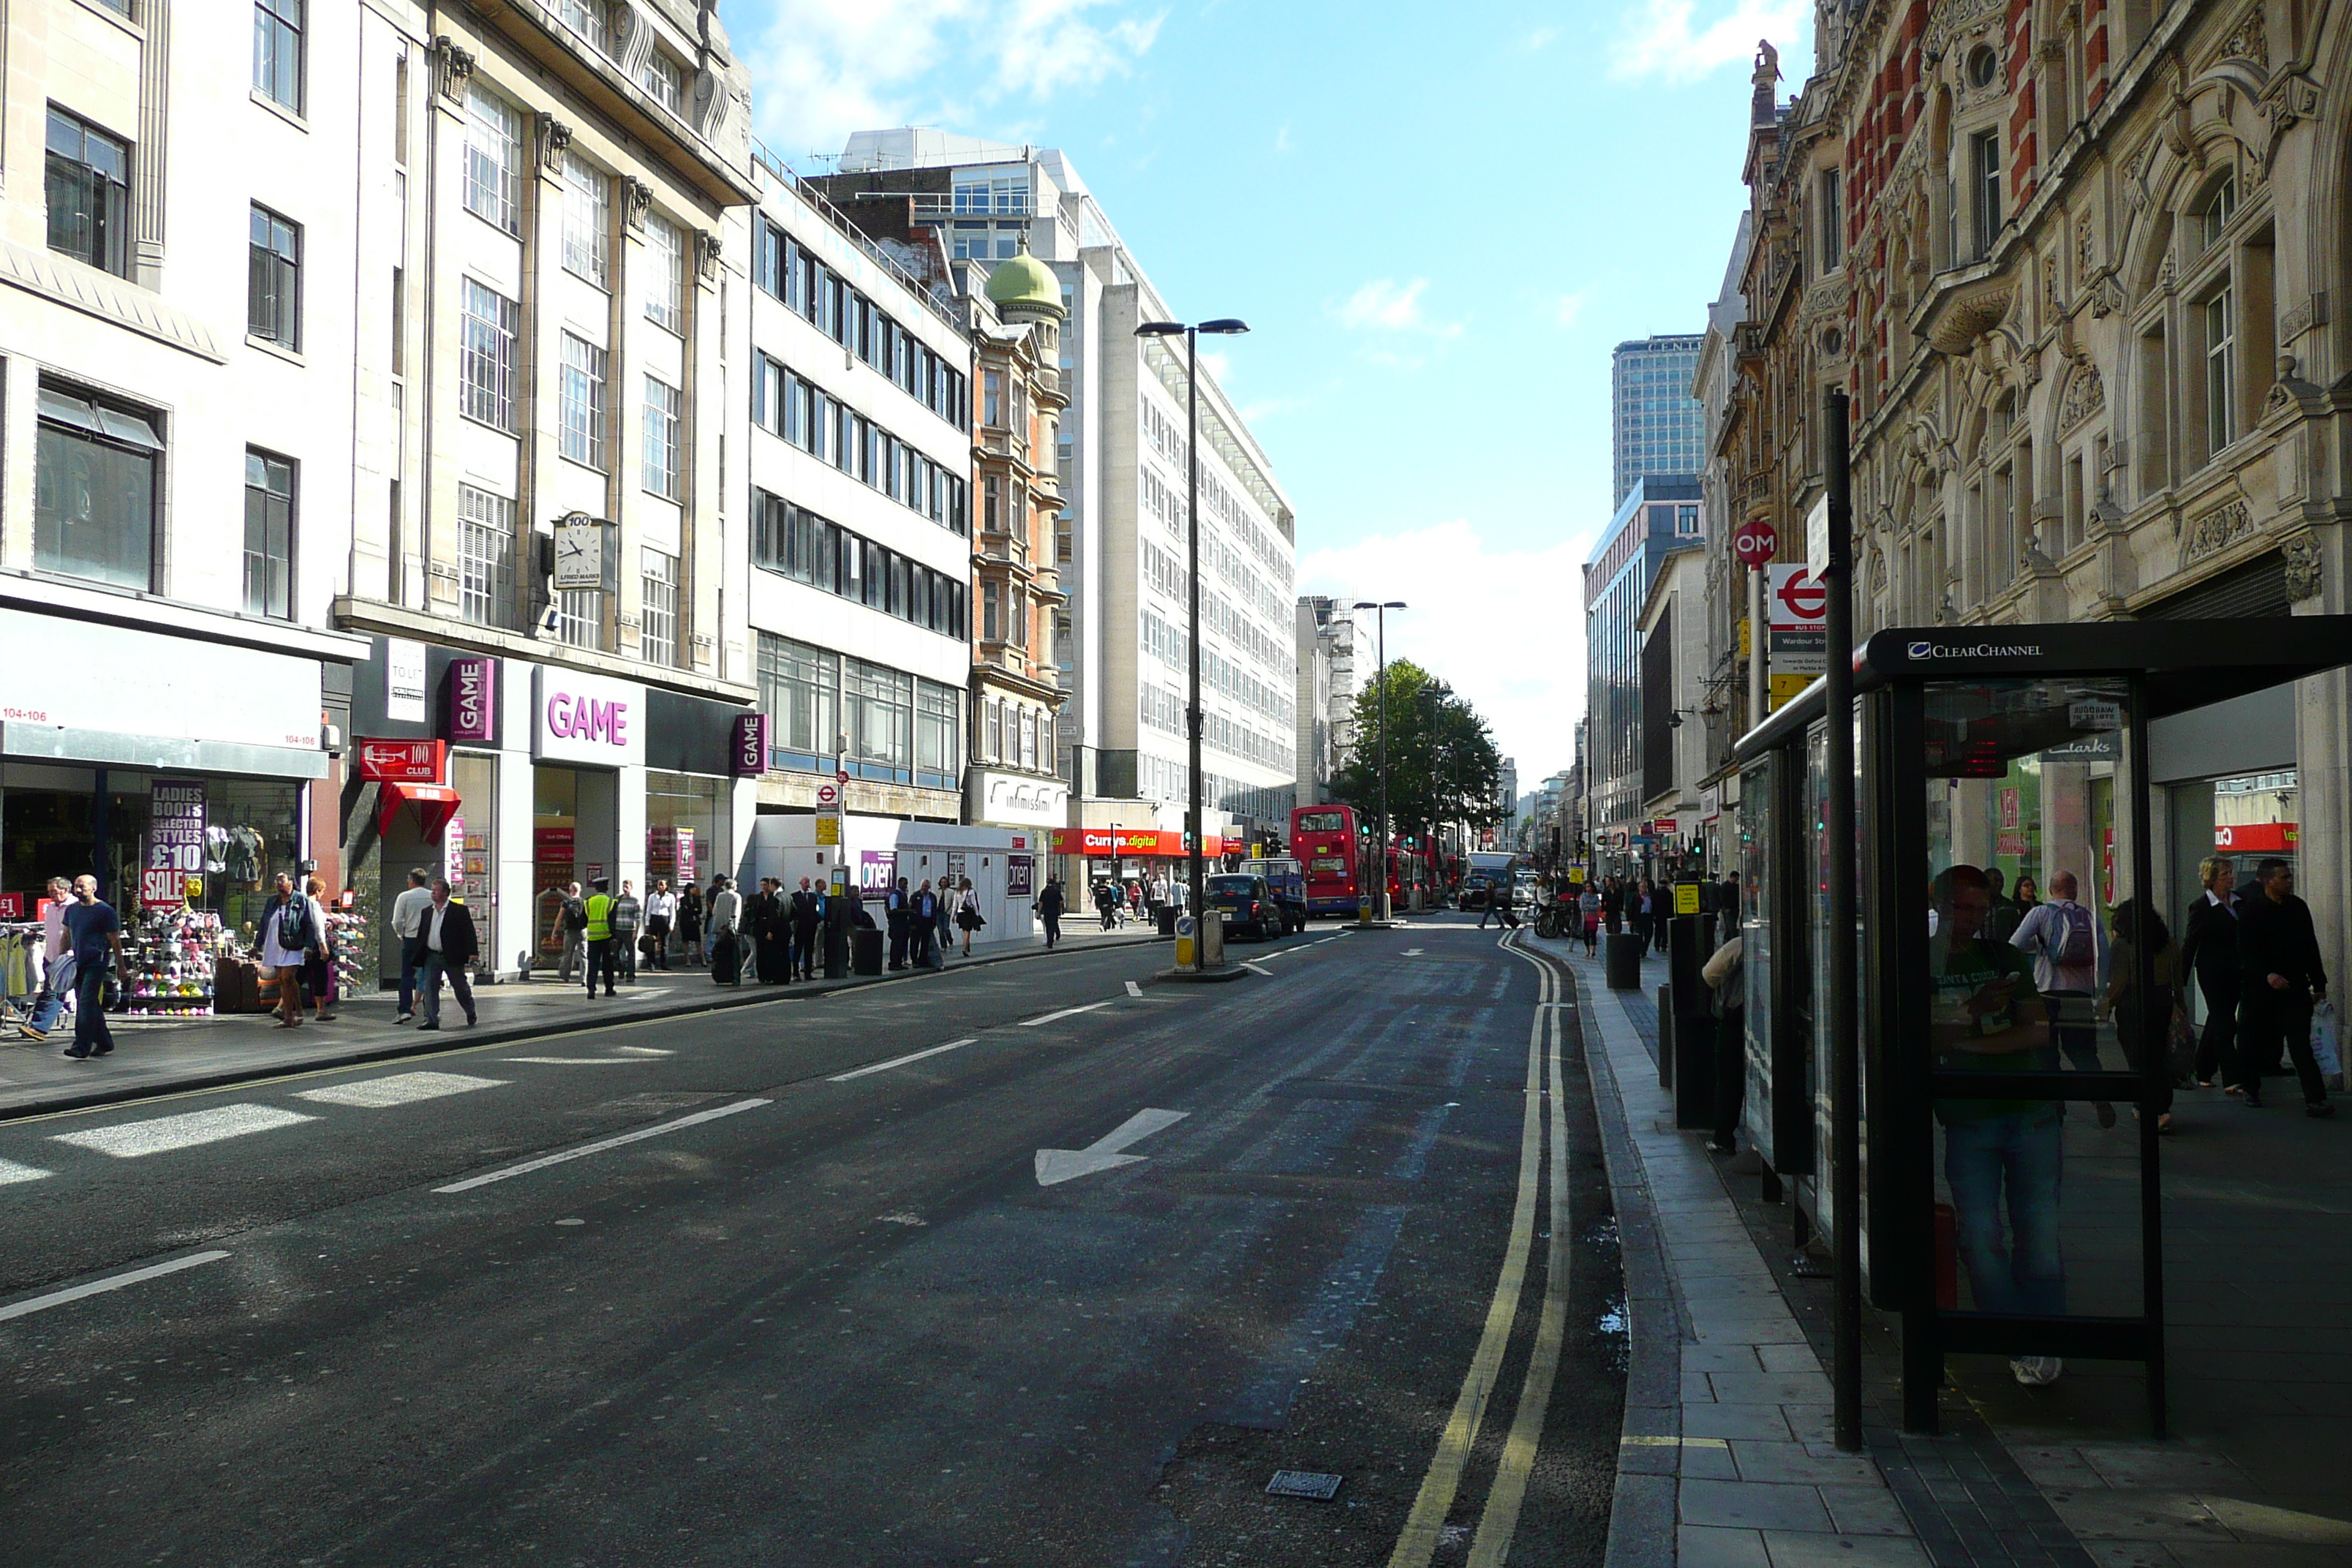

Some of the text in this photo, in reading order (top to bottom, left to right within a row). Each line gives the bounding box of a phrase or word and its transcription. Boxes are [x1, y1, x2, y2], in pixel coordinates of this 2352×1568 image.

[569, 517, 589, 527] 100
[1737, 535, 1774, 552] OM
[393, 666, 406, 677] TO
[460, 663, 478, 729] GAME
[3, 707, 47, 722] 104-106
[549, 692, 627, 746] GAME
[285, 735, 315, 745] 104-106
[744, 717, 758, 766] GAME
[411, 745, 429, 764] 100
[406, 766, 431, 775] CLUB
[153, 787, 203, 802] LADIES
[153, 802, 202, 817] BOOTS
[2000, 787, 2019, 829] NEW
[152, 818, 202, 829] SELECTED
[152, 829, 202, 844] STYLES
[151, 844, 201, 871] £10
[145, 871, 183, 900] SALE
[0, 899, 14, 912] £1
